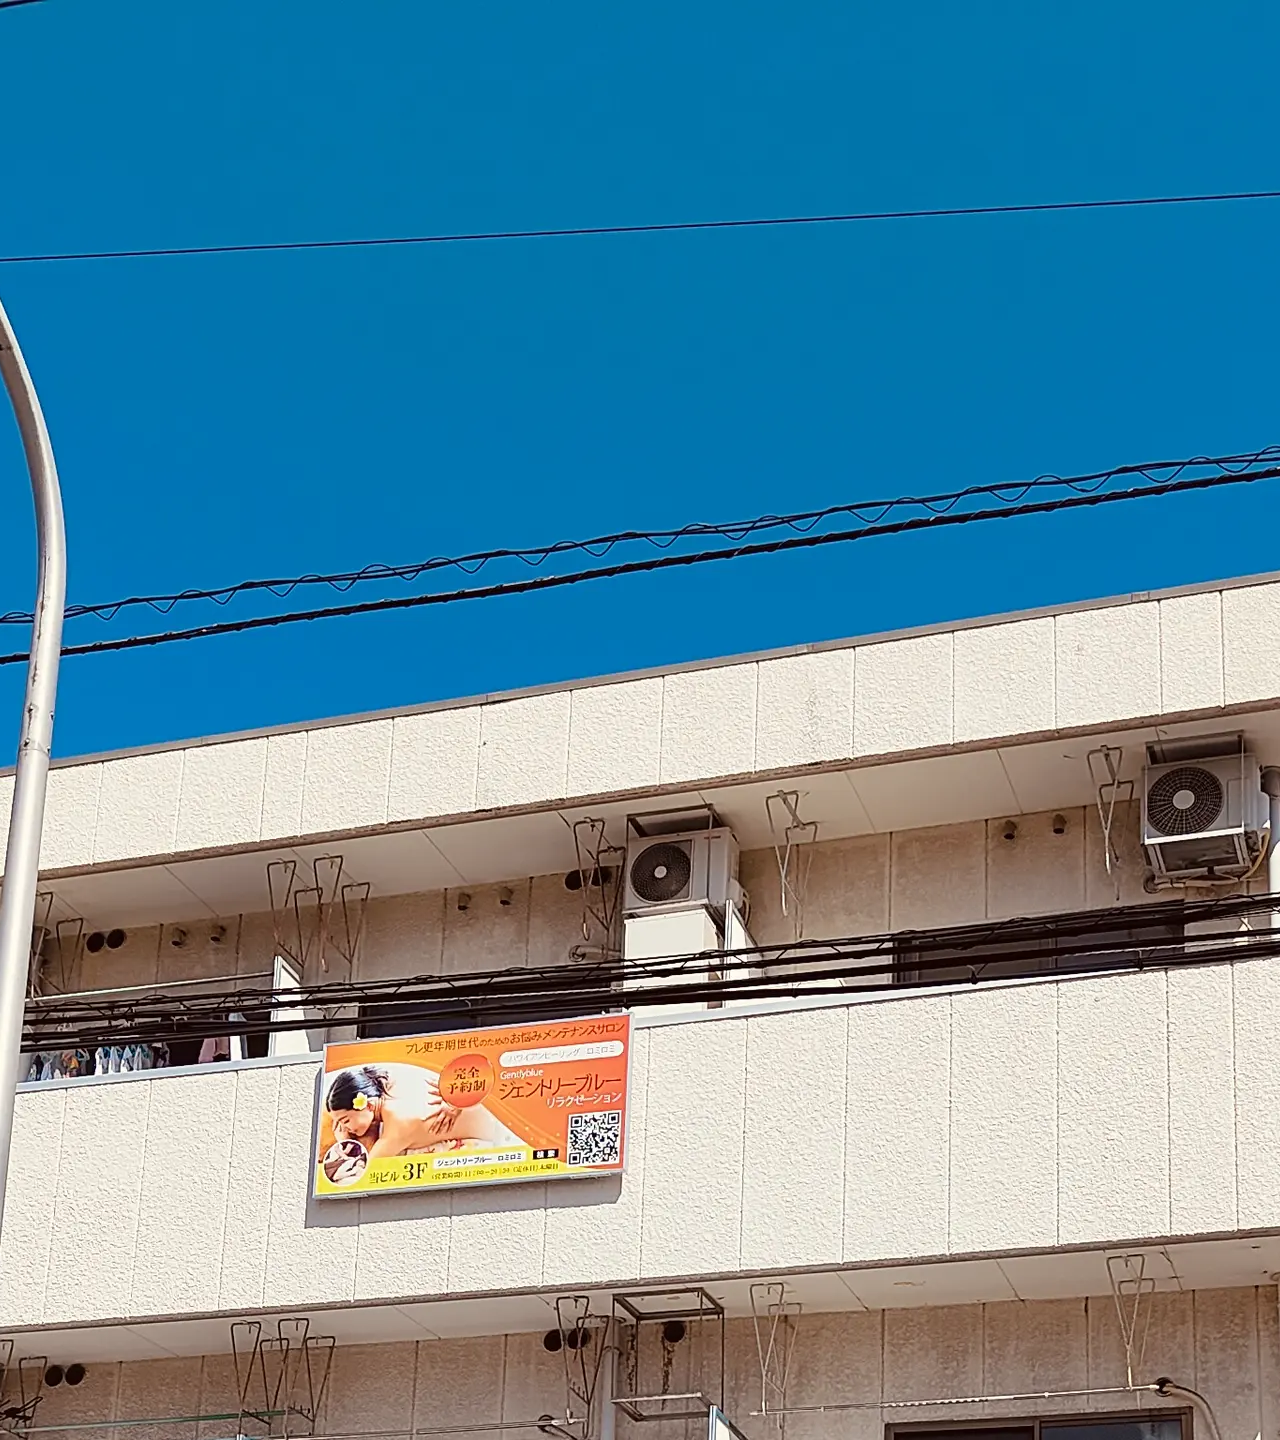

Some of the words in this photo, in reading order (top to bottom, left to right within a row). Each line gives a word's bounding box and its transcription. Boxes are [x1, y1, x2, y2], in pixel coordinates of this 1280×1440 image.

[454, 1066, 480, 1081] 完全
[447, 1079, 486, 1095] 予約制
[499, 1073, 622, 1100] ジェントリーブルー
[547, 1091, 622, 1108] リラクゼーション
[403, 1162, 428, 1181] 3F
